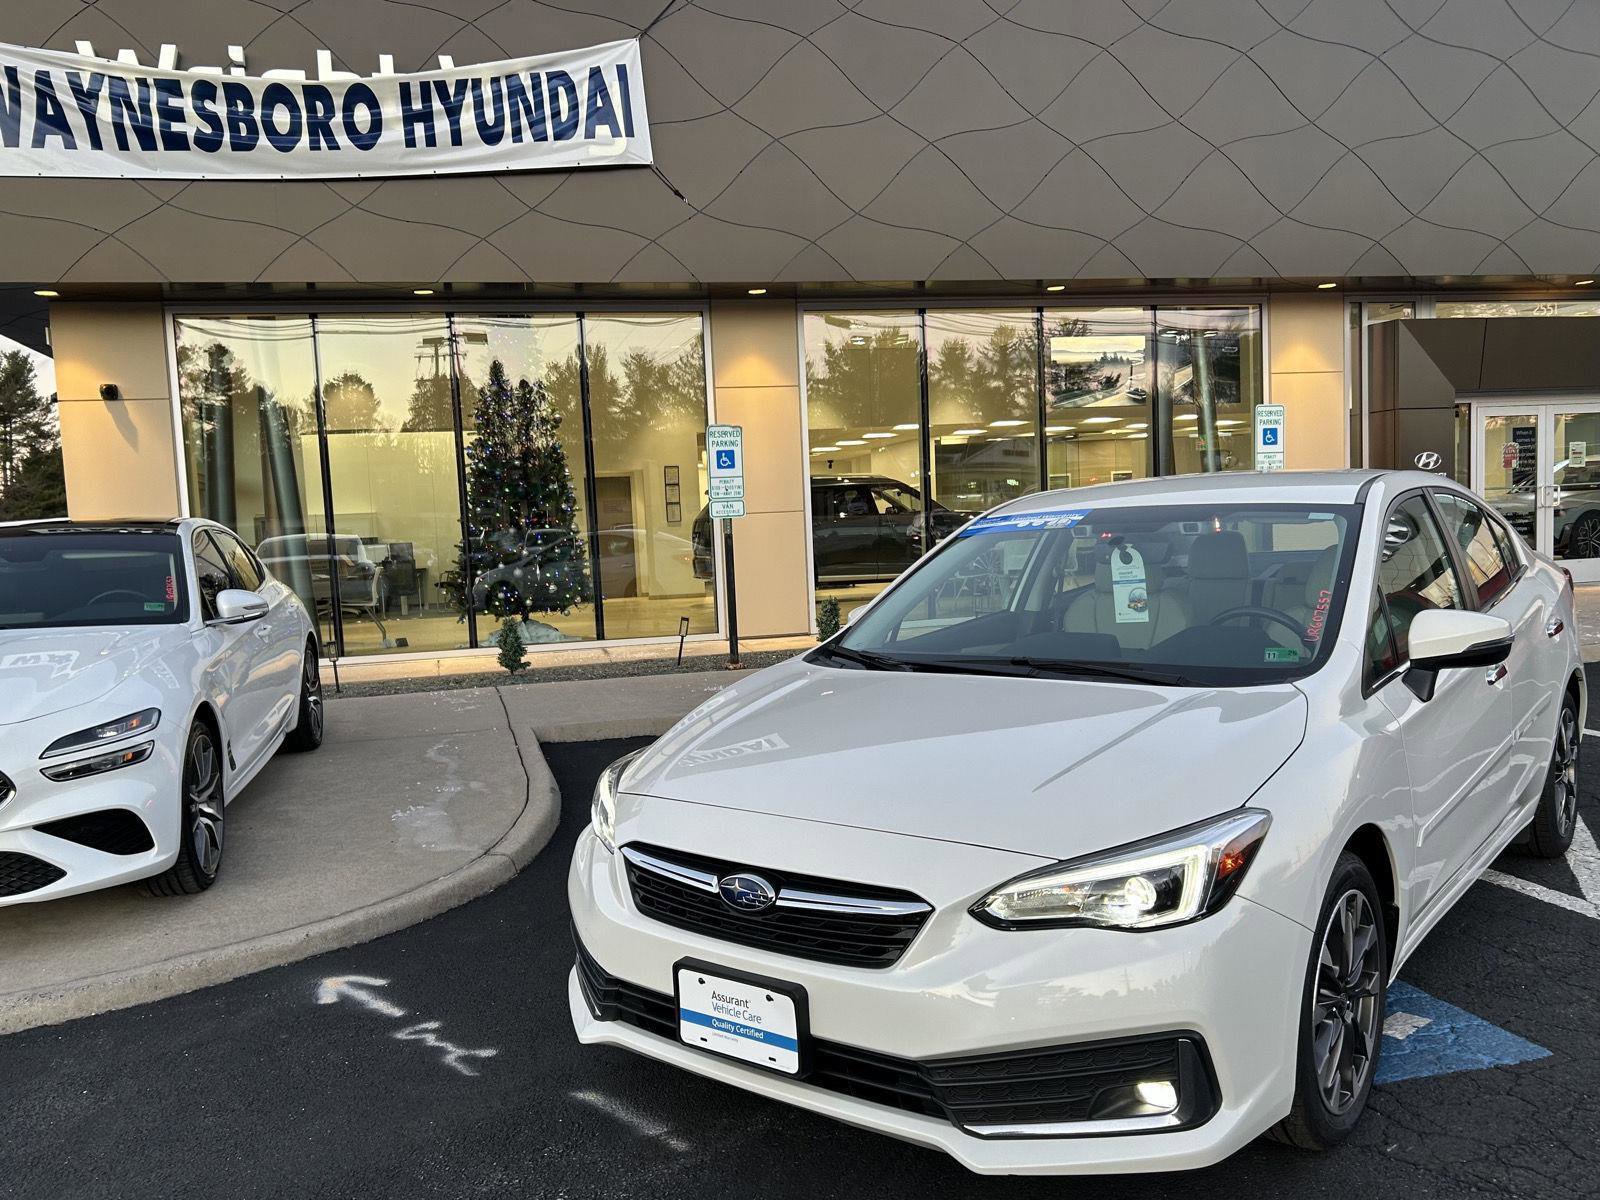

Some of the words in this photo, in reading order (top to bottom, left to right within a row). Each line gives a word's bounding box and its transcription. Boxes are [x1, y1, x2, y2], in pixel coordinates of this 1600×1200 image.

[398, 62, 635, 149] HYUNDAI
[1533, 303, 1558, 315] 2551
[709, 430, 740, 438] RESERVED
[711, 440, 739, 448] PARKING
[711, 990, 750, 1009] Assurant
[711, 1002, 742, 1019] Vehicle
[742, 1010, 762, 1024] Care
[711, 1018, 735, 1033] Quality
[735, 1024, 764, 1039] Certified
